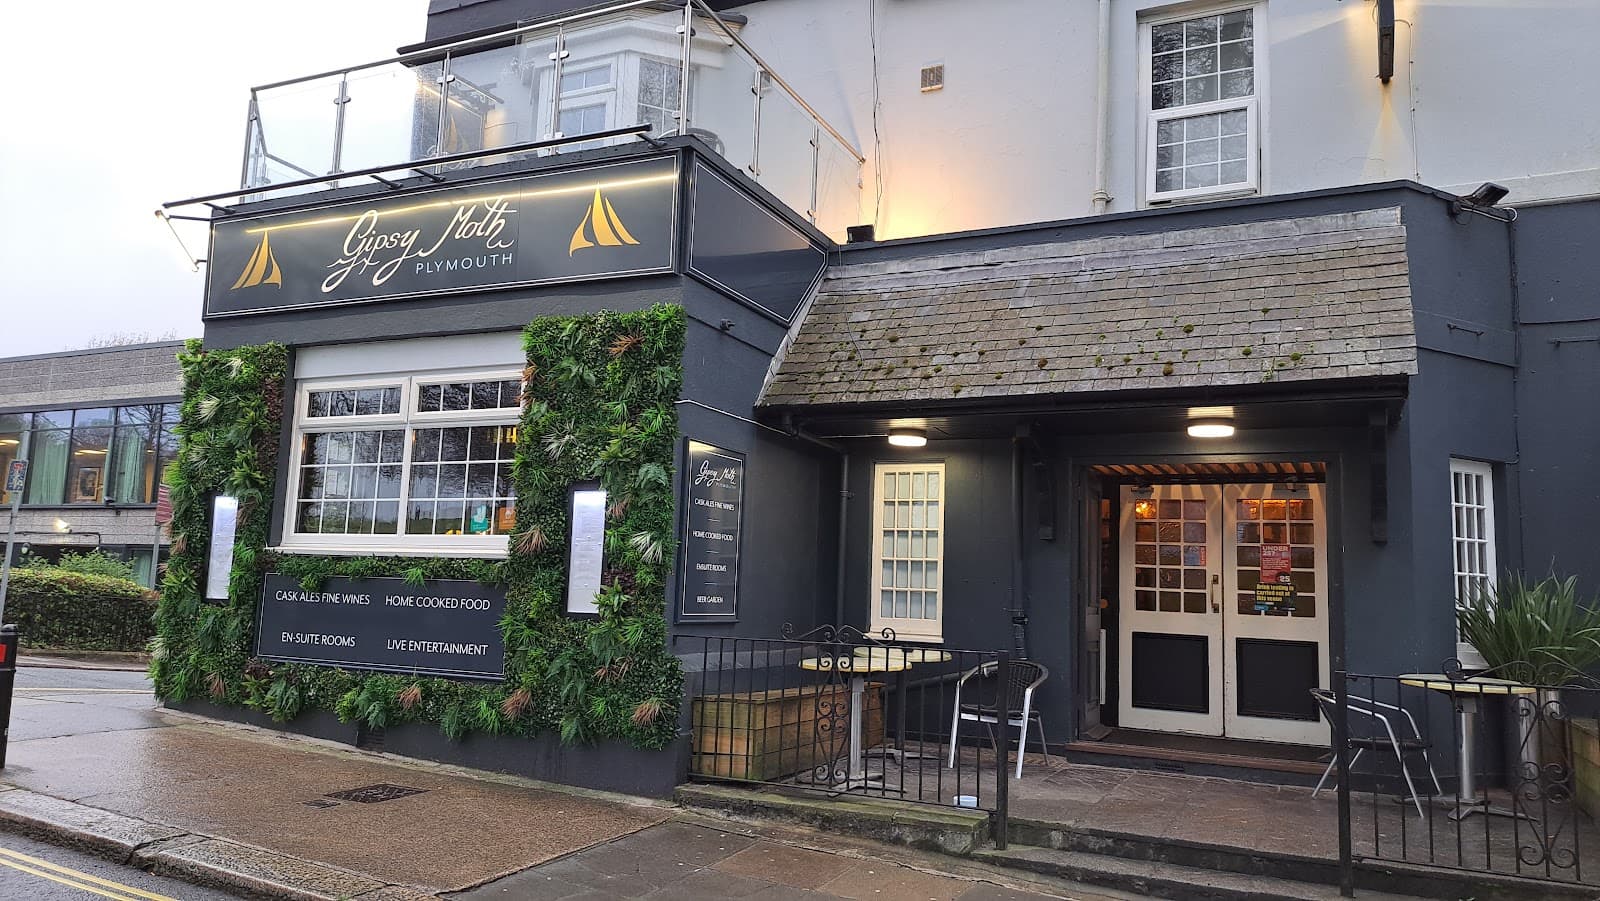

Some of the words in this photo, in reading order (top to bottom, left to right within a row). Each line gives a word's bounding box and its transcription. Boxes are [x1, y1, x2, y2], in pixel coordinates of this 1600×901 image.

[321, 210, 420, 293] Gipsy
[418, 195, 517, 257] Moth
[416, 253, 512, 274] PLYMOUTH
[693, 530, 705, 538] HOME
[722, 533, 734, 541] FOOD
[275, 590, 298, 601] CASK
[299, 591, 320, 603] ALES
[322, 592, 340, 604] FINE
[342, 593, 370, 605] WINES
[385, 595, 414, 607] HOME
[416, 596, 458, 609] COOKED
[460, 598, 490, 611] FOOD
[281, 631, 320, 645] EN-SUITE
[321, 634, 356, 647] ROOMS
[387, 639, 406, 651] LIVE
[408, 640, 489, 656] ENTERTAINMENT
